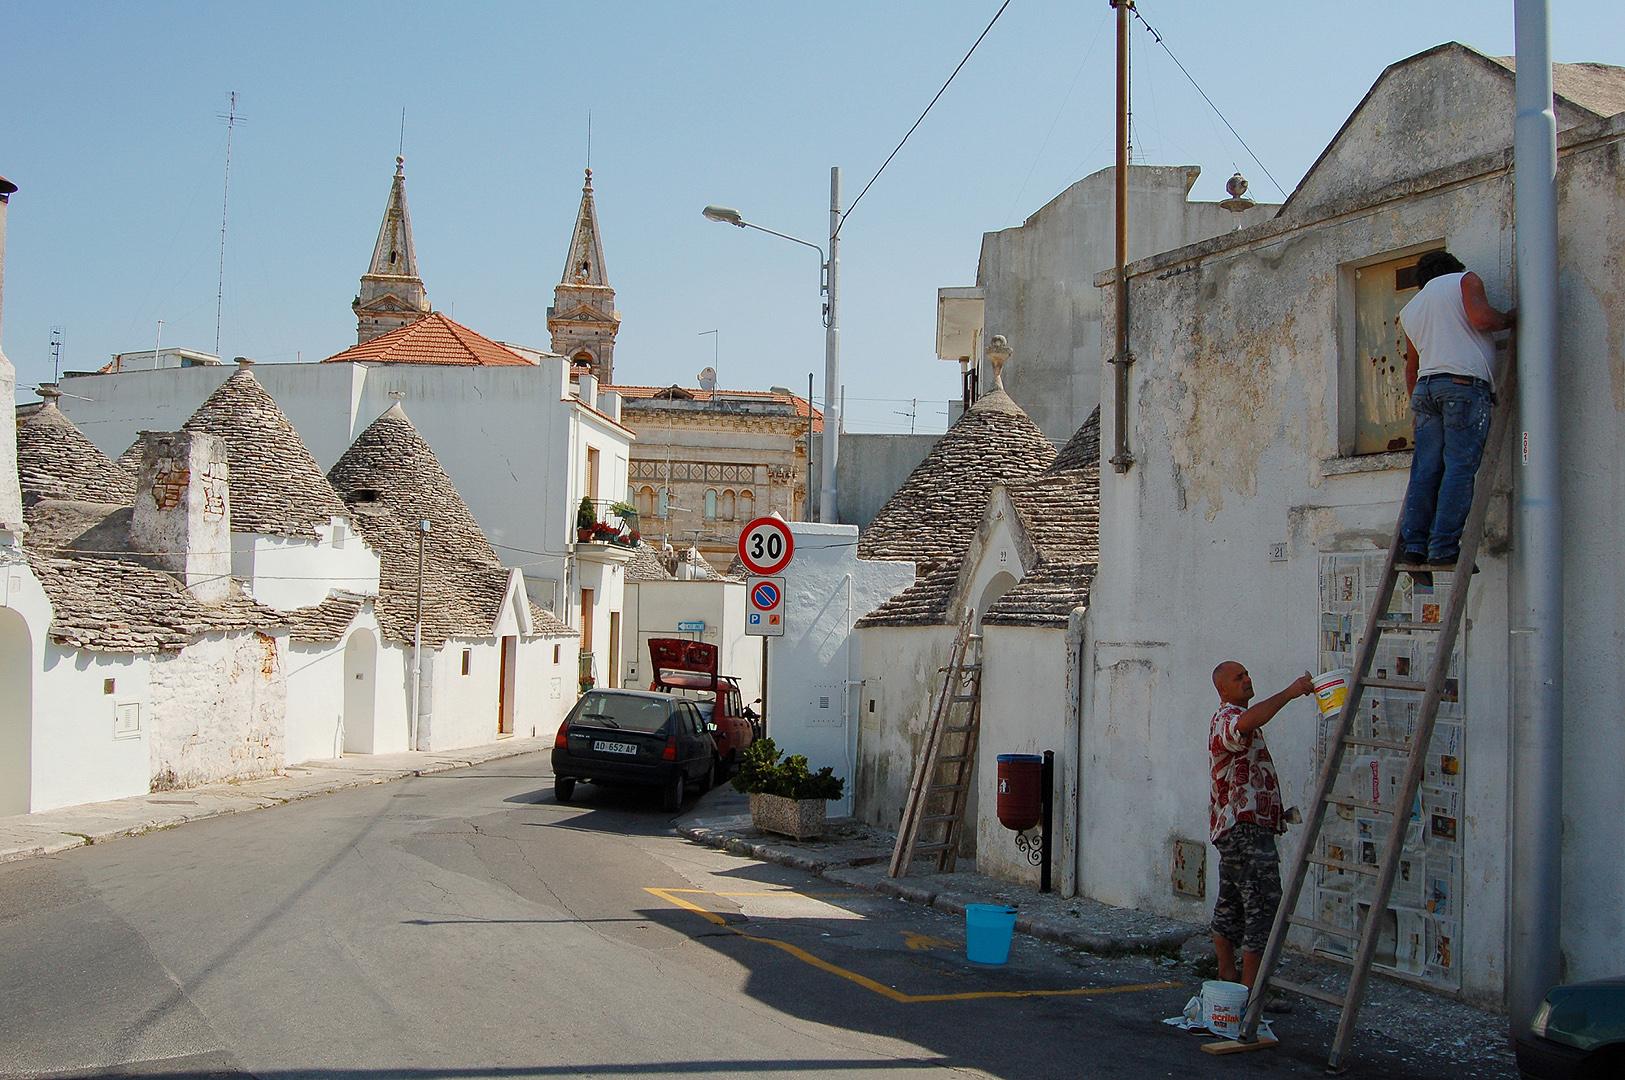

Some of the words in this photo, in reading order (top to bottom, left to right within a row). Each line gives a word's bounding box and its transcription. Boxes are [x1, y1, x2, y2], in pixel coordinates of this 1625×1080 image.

[751, 533, 782, 559] 30
[1274, 547, 1283, 558] 21
[751, 614, 759, 624] P
[595, 742, 605, 750] AD
[608, 743, 623, 752] 652
[626, 745, 635, 753] AP
